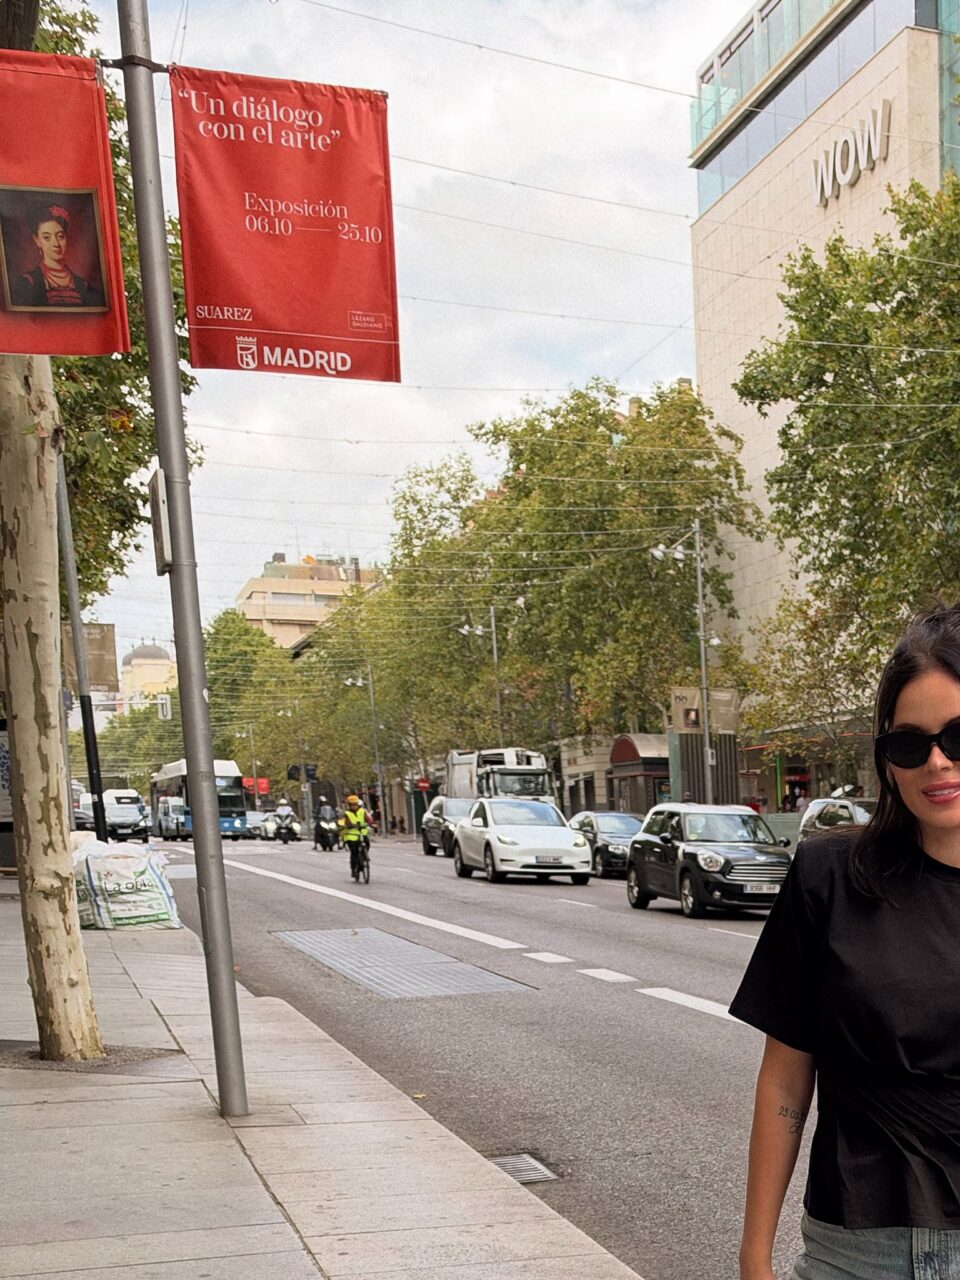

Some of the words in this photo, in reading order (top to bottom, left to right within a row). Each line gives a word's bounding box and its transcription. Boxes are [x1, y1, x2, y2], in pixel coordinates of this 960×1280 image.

[178, 89, 225, 116] “Un
[232, 96, 323, 131] diálogo
[199, 119, 245, 141] con
[252, 122, 274, 144] el
[280, 129, 341, 152] arte”
[811, 98, 892, 207] WOW
[244, 192, 348, 219] Exposición
[245, 214, 293, 236] 06.10
[337, 222, 382, 244] 25.10
[196, 305, 253, 321] SUAREZ
[263, 346, 352, 374] MADRID
